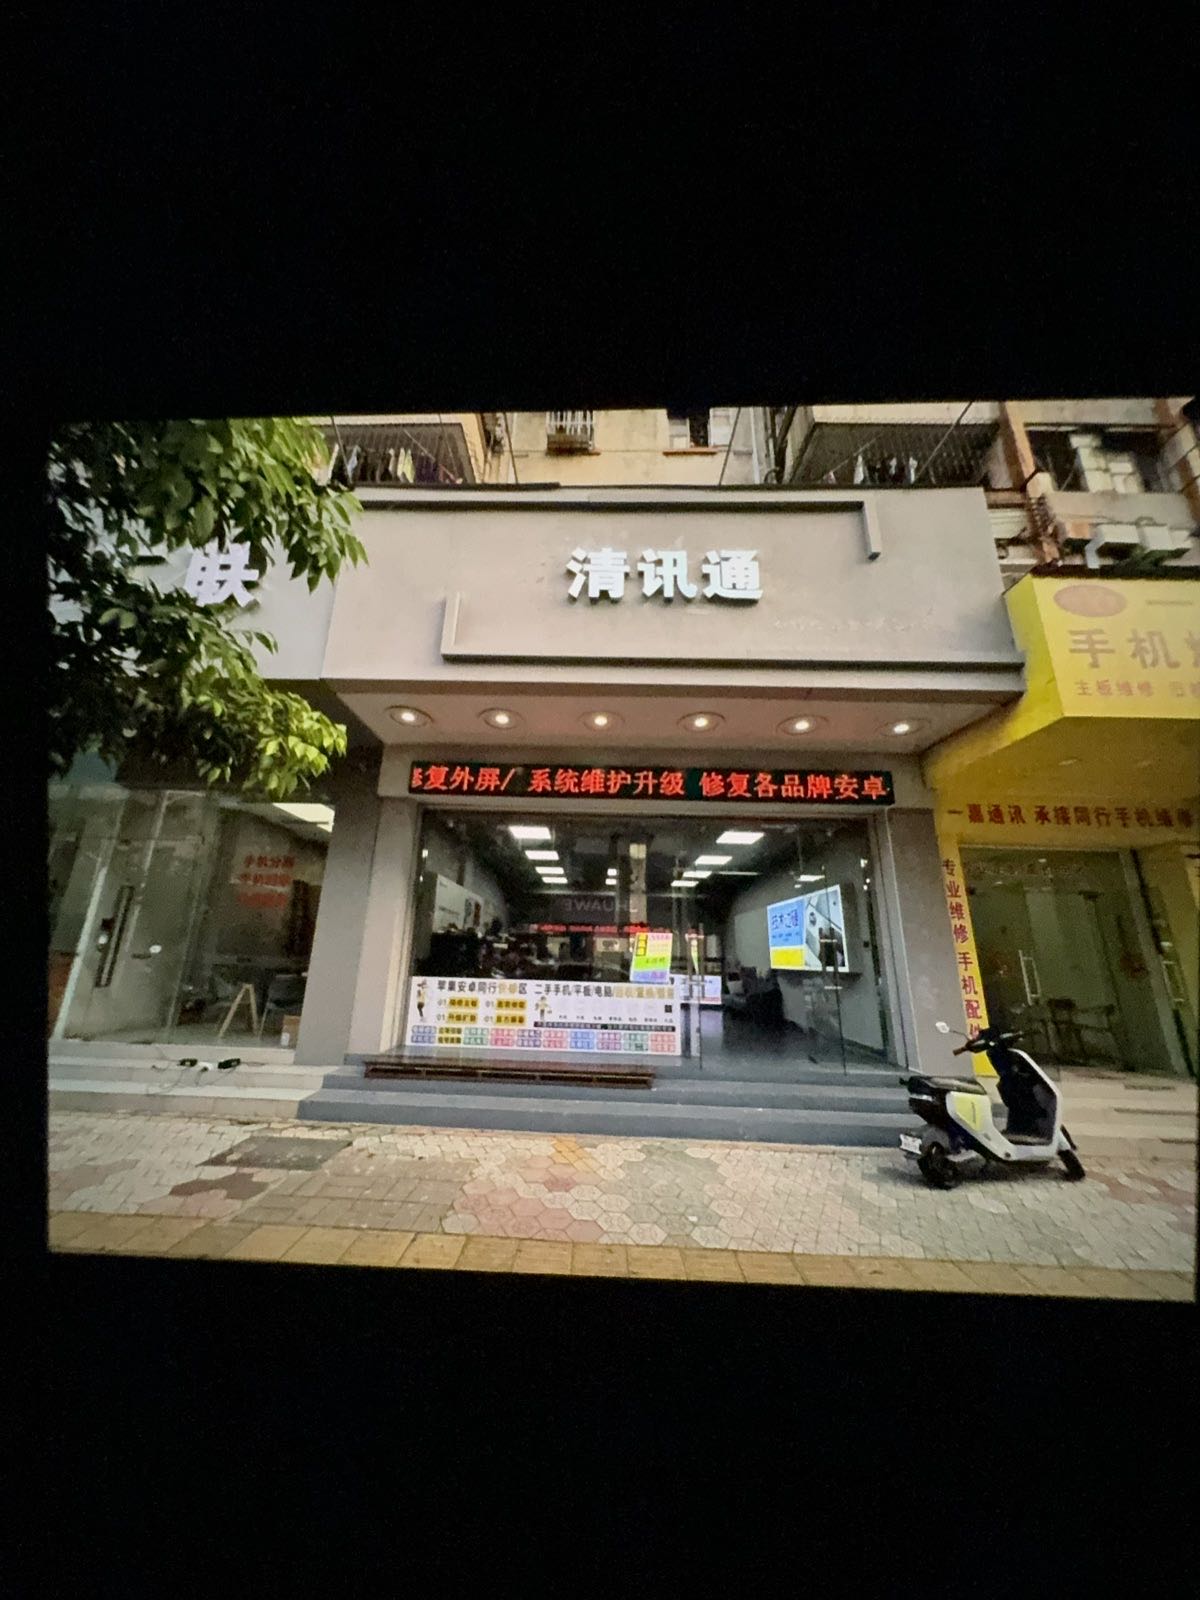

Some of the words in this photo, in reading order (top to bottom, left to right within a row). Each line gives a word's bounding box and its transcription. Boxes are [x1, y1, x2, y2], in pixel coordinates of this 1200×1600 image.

[566, 547, 764, 604] 清讯通
[527, 768, 685, 797] 系统维护升级
[700, 771, 887, 801] 修复各品牌安卓
[942, 859, 969, 944] 专业维修
